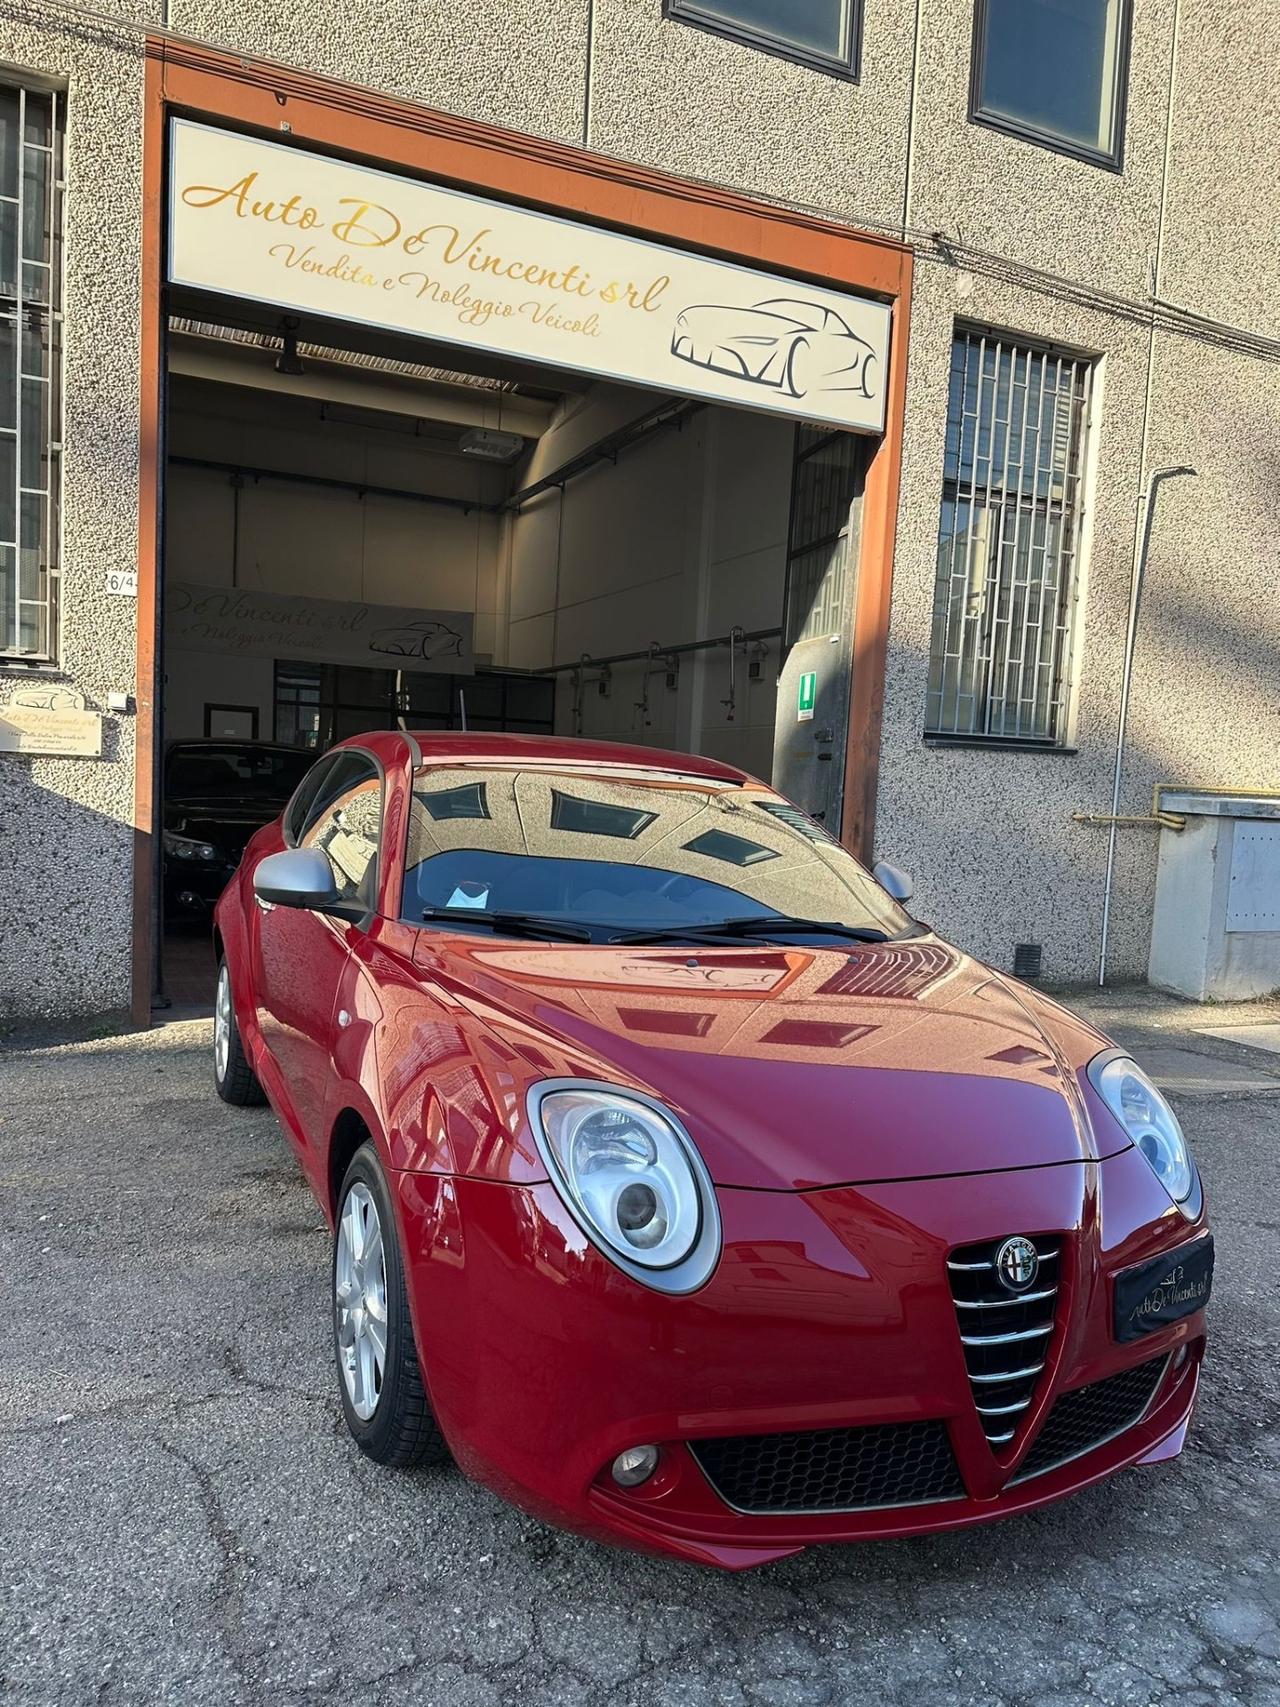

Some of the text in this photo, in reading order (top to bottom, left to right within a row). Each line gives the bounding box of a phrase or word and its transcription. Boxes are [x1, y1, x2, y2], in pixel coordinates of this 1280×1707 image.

[182, 172, 325, 231] Auto
[599, 275, 671, 313] srl
[268, 244, 601, 338] Vendita e Noleggio Veicoli
[110, 575, 133, 590] 6/4
